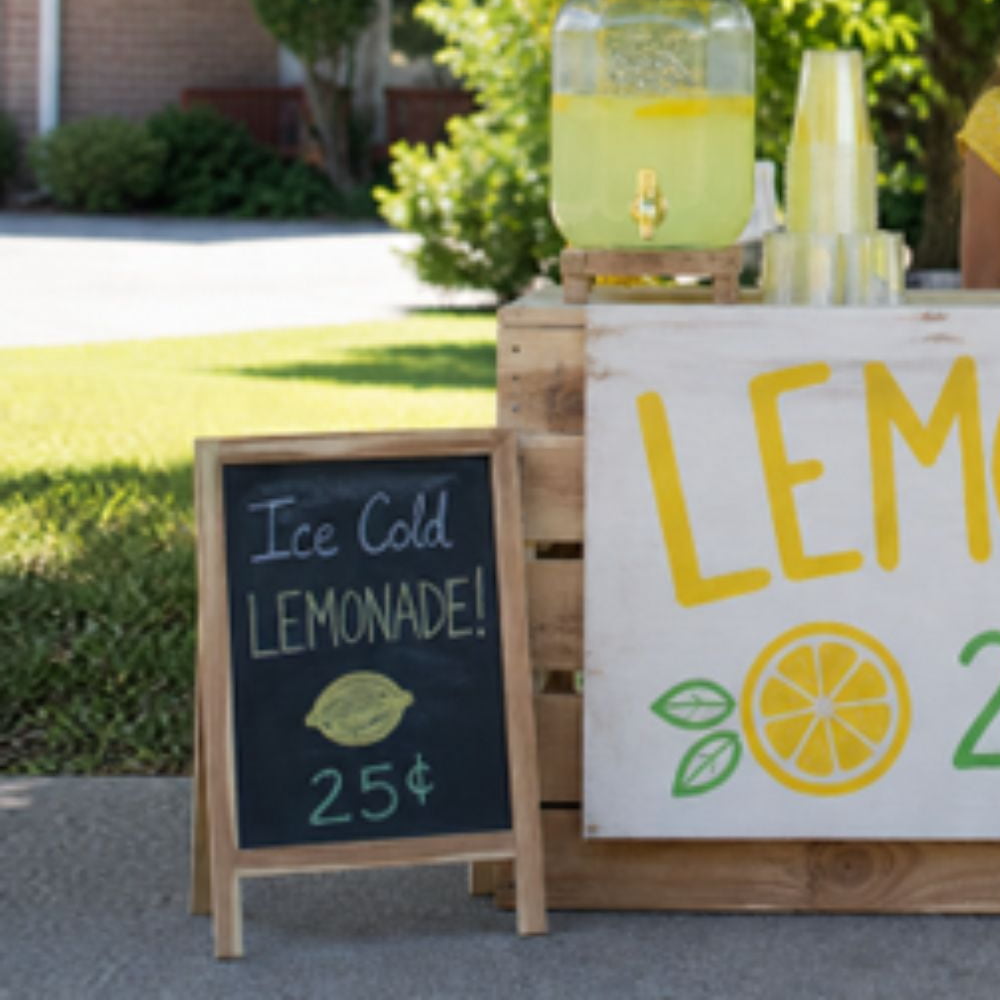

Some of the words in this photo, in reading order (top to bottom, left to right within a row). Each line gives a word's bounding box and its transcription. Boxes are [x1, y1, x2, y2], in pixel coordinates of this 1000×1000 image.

[247, 495, 339, 564] Ice
[357, 490, 454, 555] Cold
[246, 566, 486, 659] LEMONADE!
[309, 753, 435, 826] 25¢
